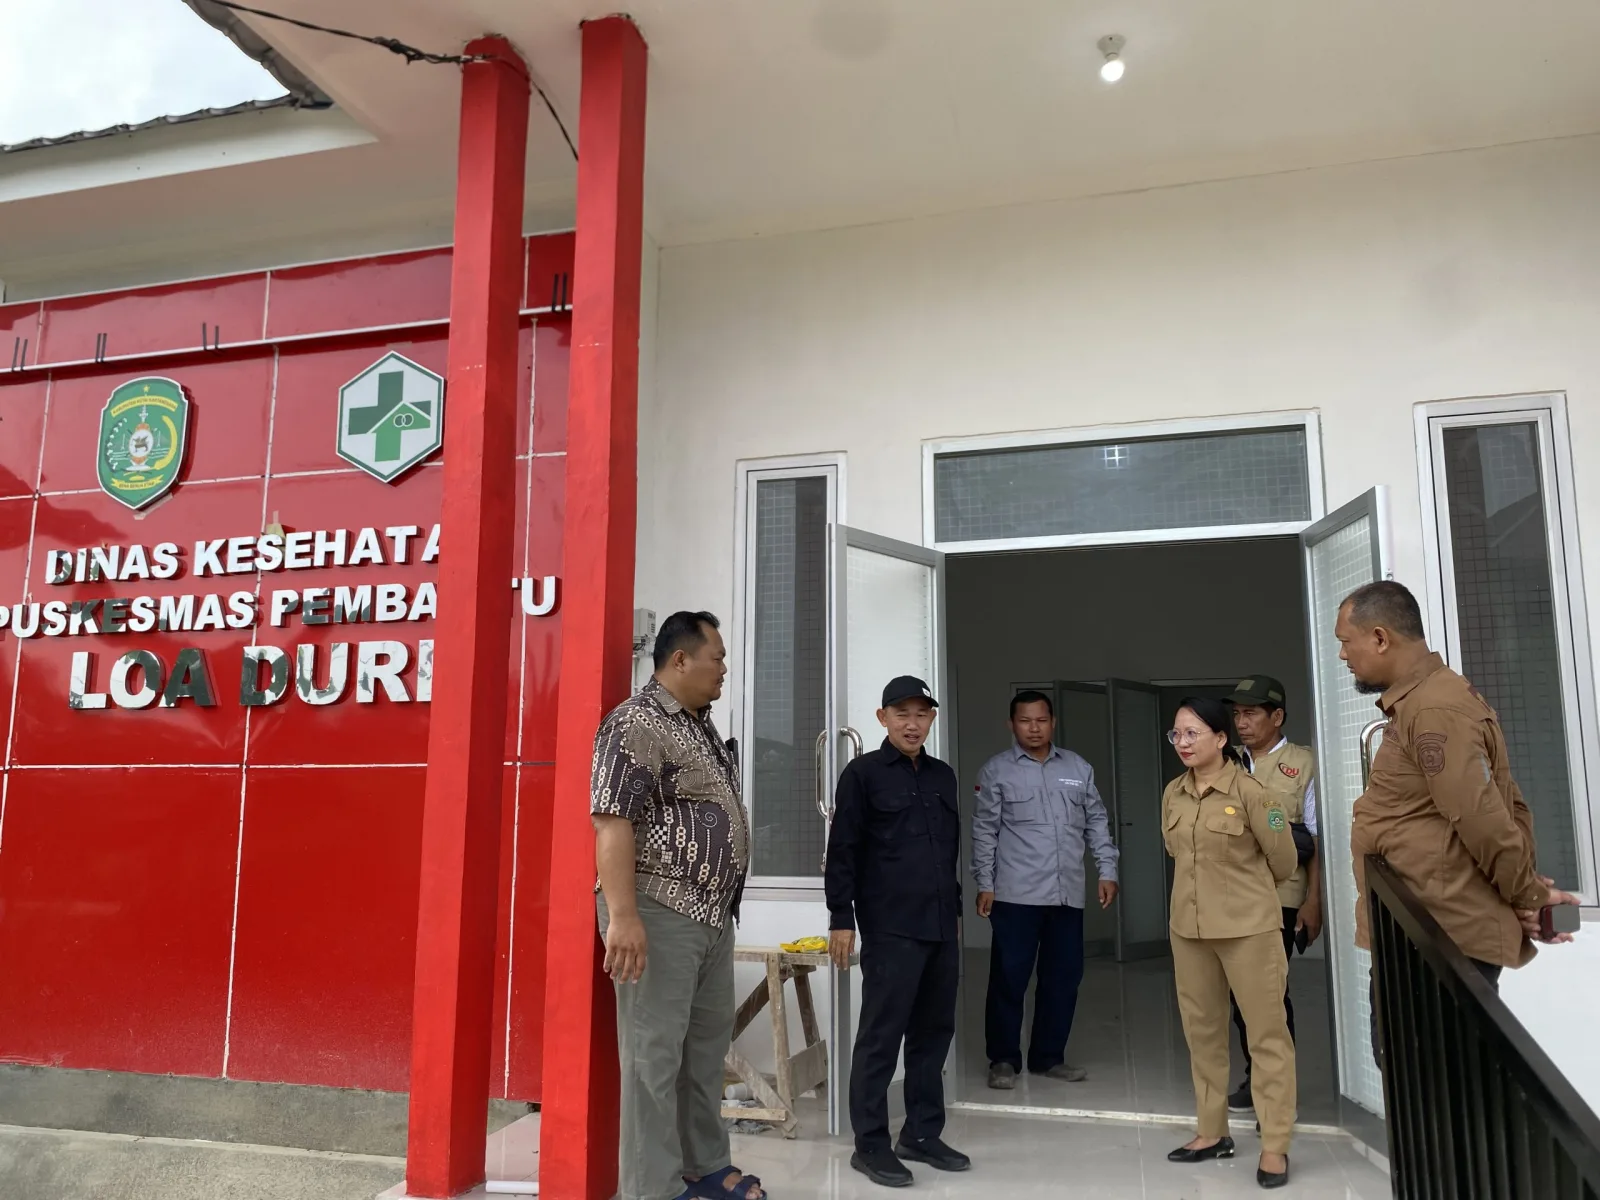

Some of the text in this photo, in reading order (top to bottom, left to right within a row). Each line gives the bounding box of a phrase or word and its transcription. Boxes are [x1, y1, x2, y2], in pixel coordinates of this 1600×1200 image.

[45, 524, 441, 584] DINAS KESEHATA
[270, 575, 556, 627] PEMBAU
[69, 639, 435, 709] LOA DURI
